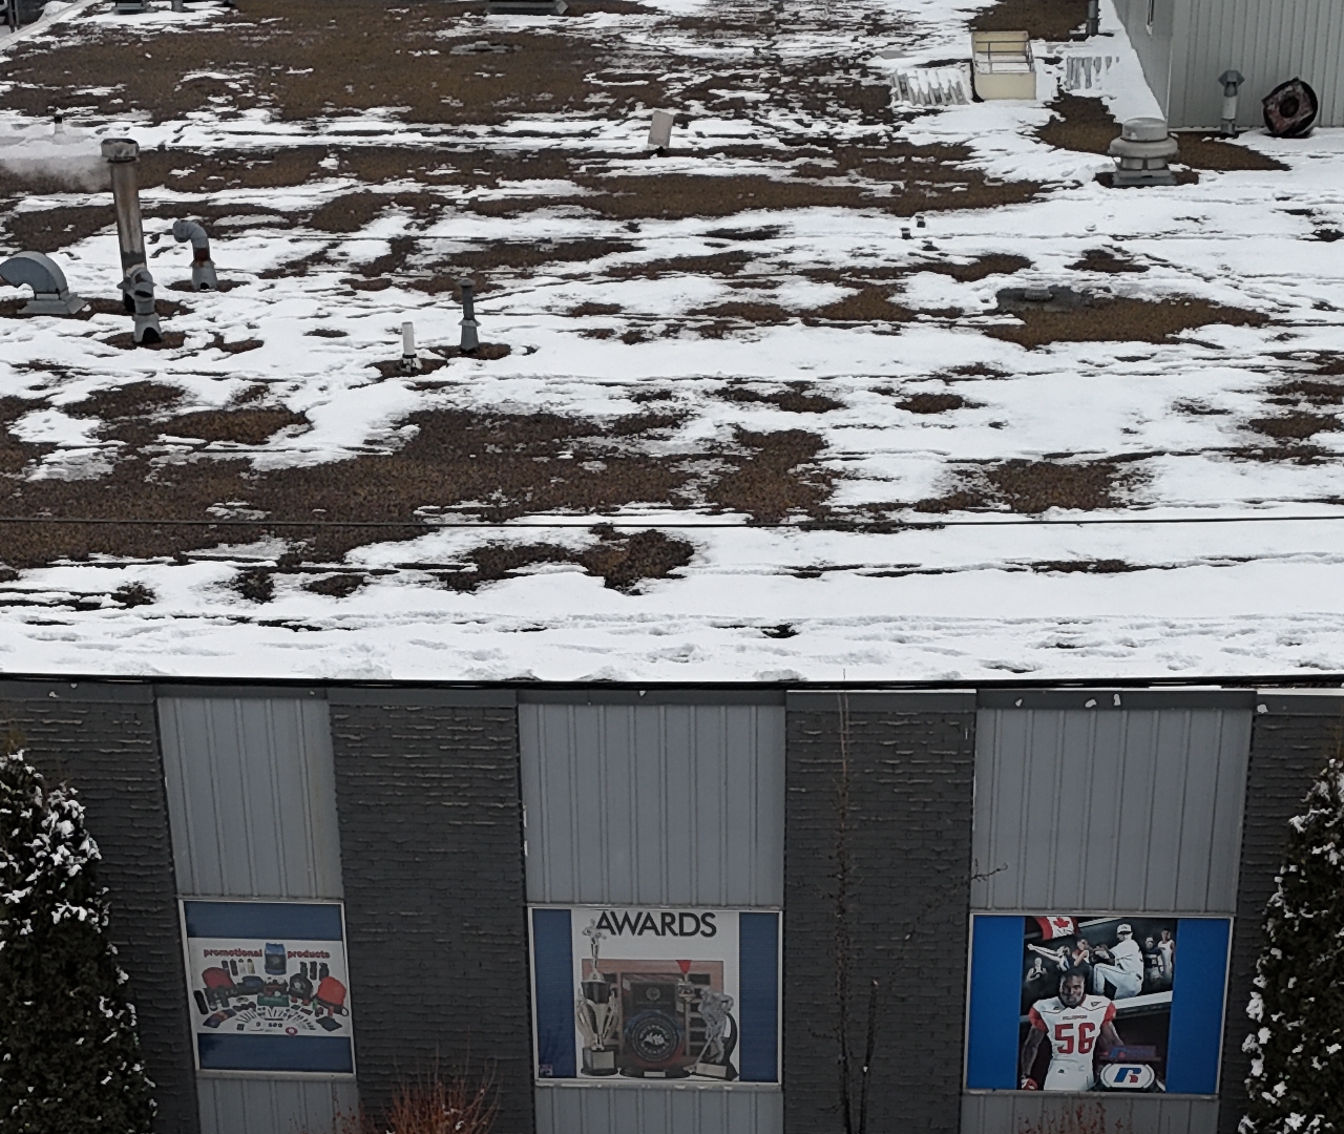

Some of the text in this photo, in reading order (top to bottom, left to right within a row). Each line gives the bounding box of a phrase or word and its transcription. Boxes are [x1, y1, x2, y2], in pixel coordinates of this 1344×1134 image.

[595, 911, 717, 937] AWARDS
[203, 947, 330, 959] promotional products
[1054, 1022, 1096, 1054] 56
